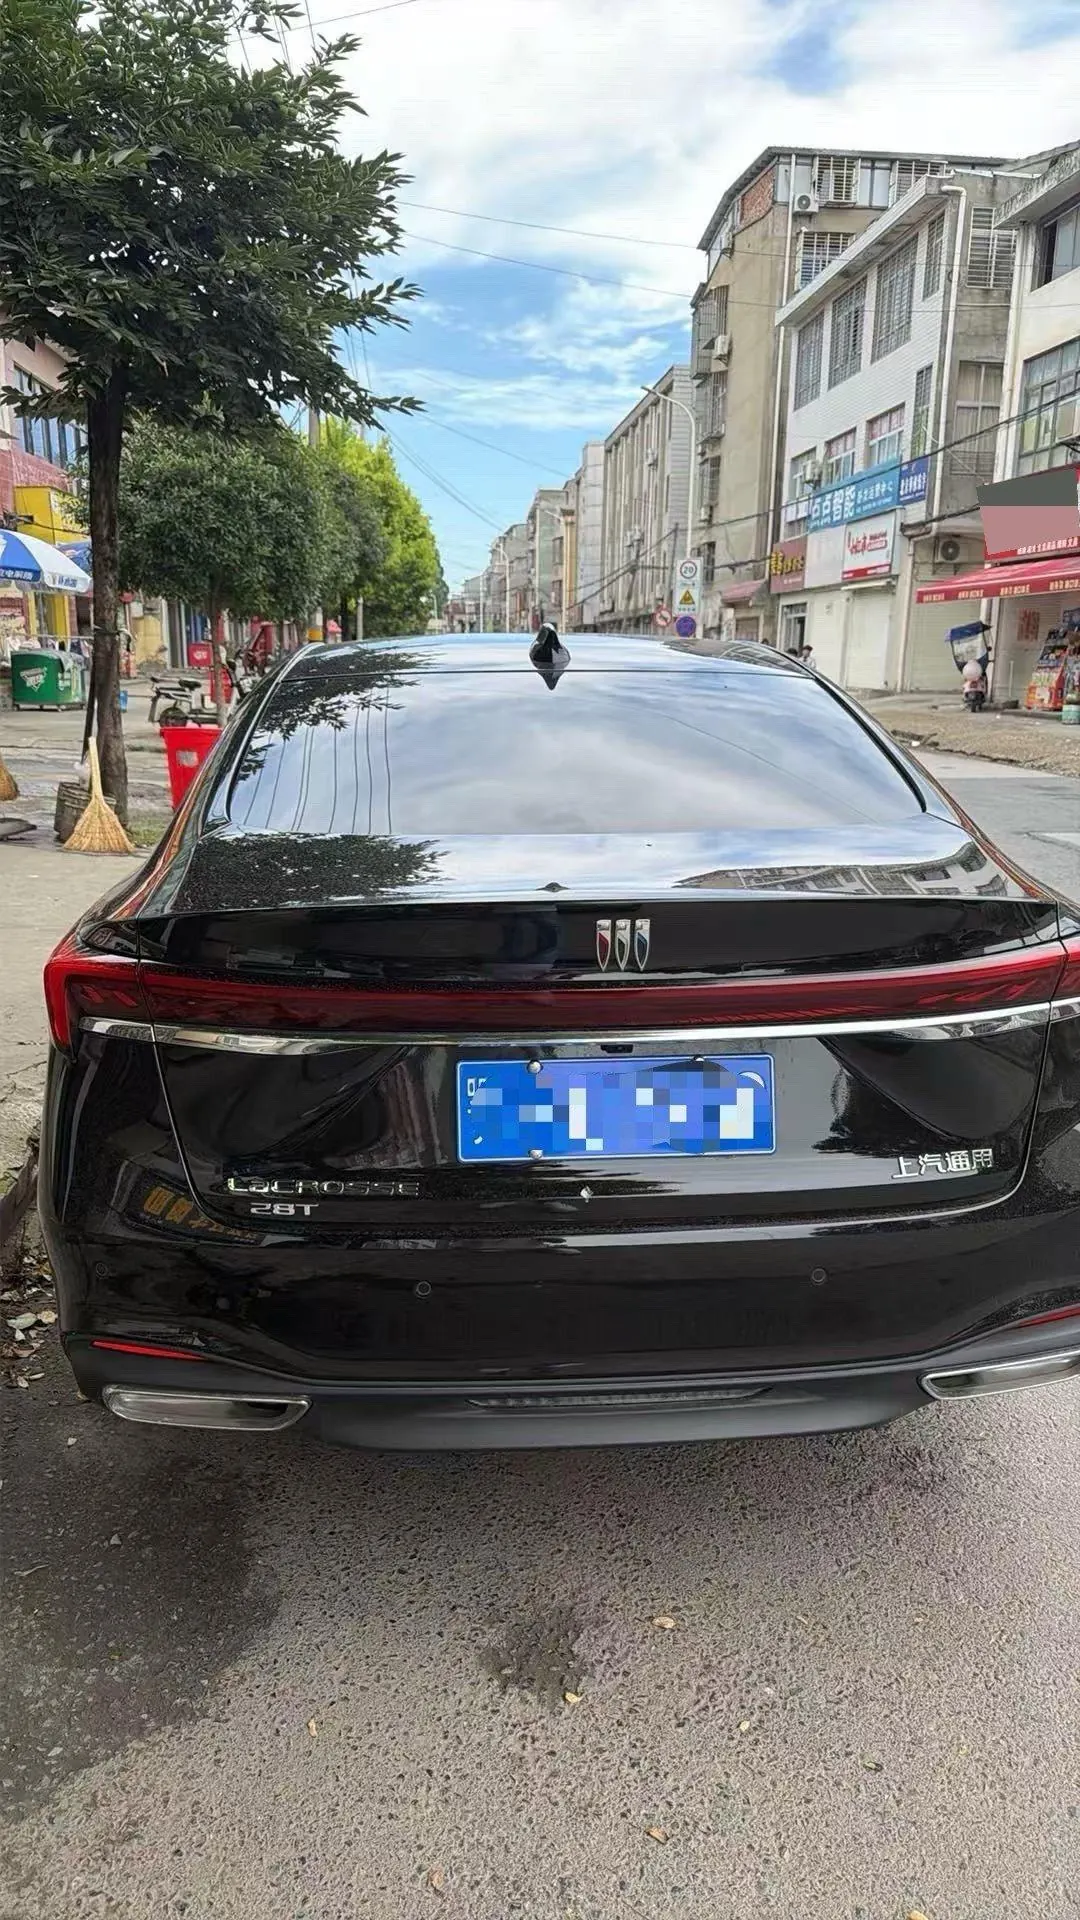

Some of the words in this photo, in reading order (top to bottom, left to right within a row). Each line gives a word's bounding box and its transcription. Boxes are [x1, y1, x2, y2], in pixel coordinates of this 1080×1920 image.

[683, 566, 694, 575] 20
[891, 1148, 994, 1180] 上汽通用
[249, 1202, 320, 1217] 28T
